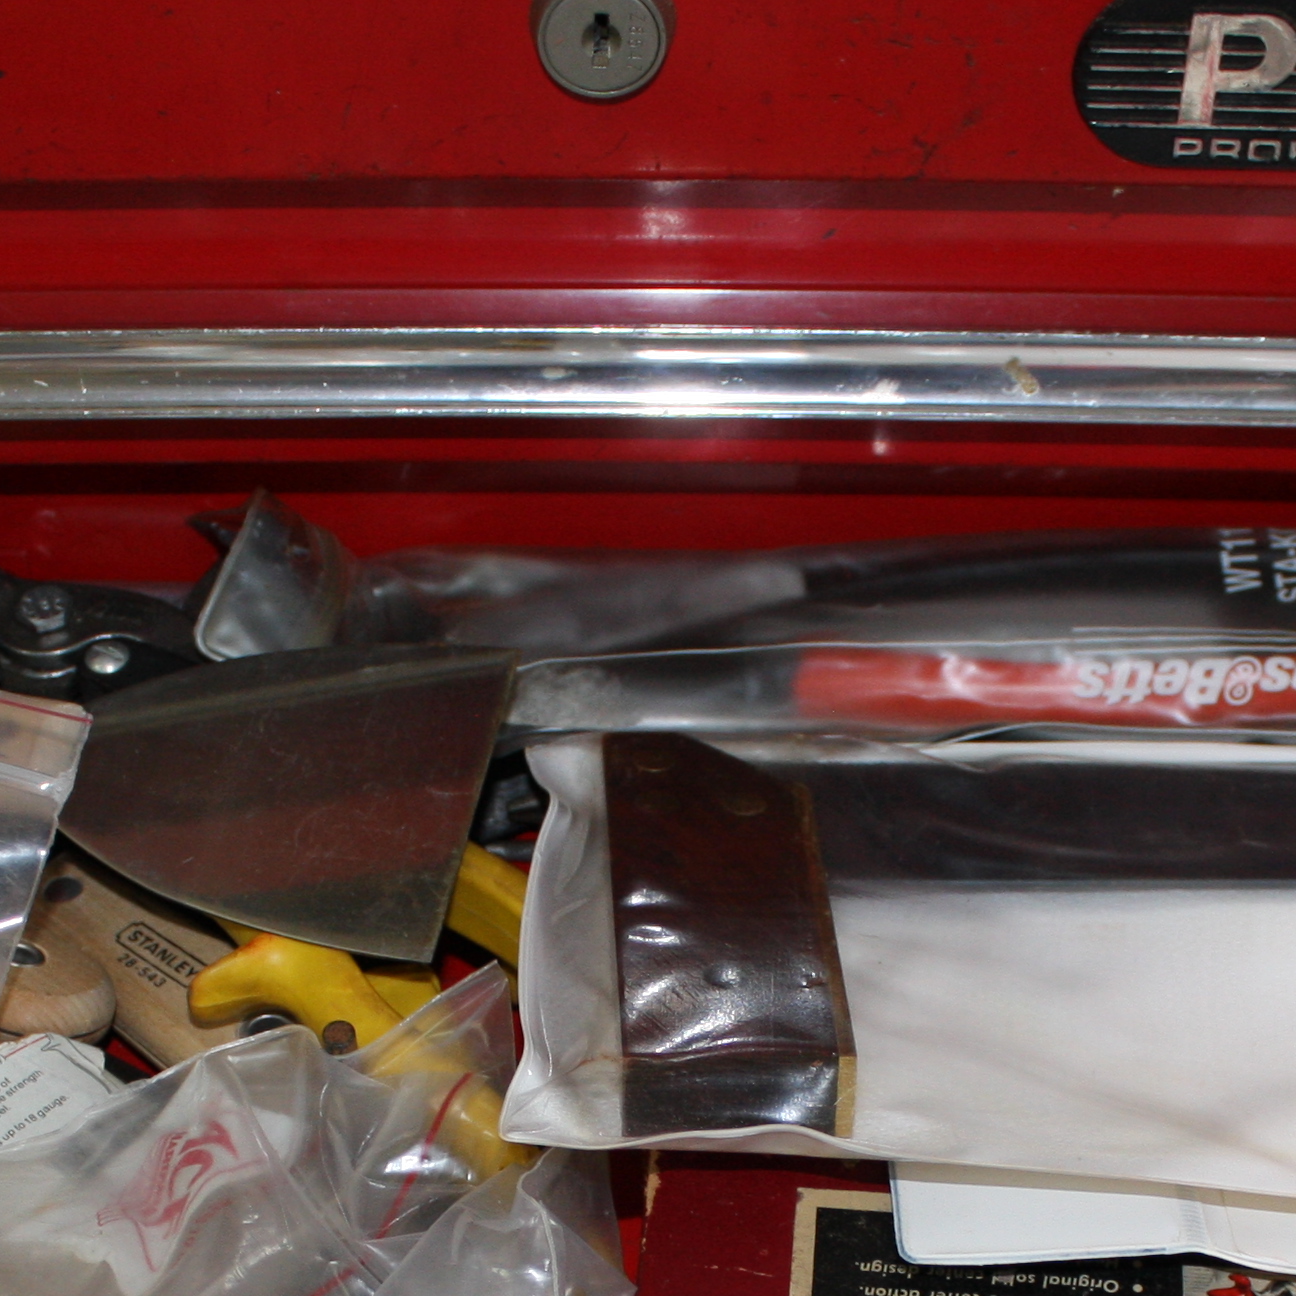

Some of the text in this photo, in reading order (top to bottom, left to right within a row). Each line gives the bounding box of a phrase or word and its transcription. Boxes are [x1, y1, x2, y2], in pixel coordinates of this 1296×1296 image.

[127, 929, 202, 978] STANLEY
[853, 1261, 921, 1279] design.
[1042, 1273, 1120, 1293] Original
